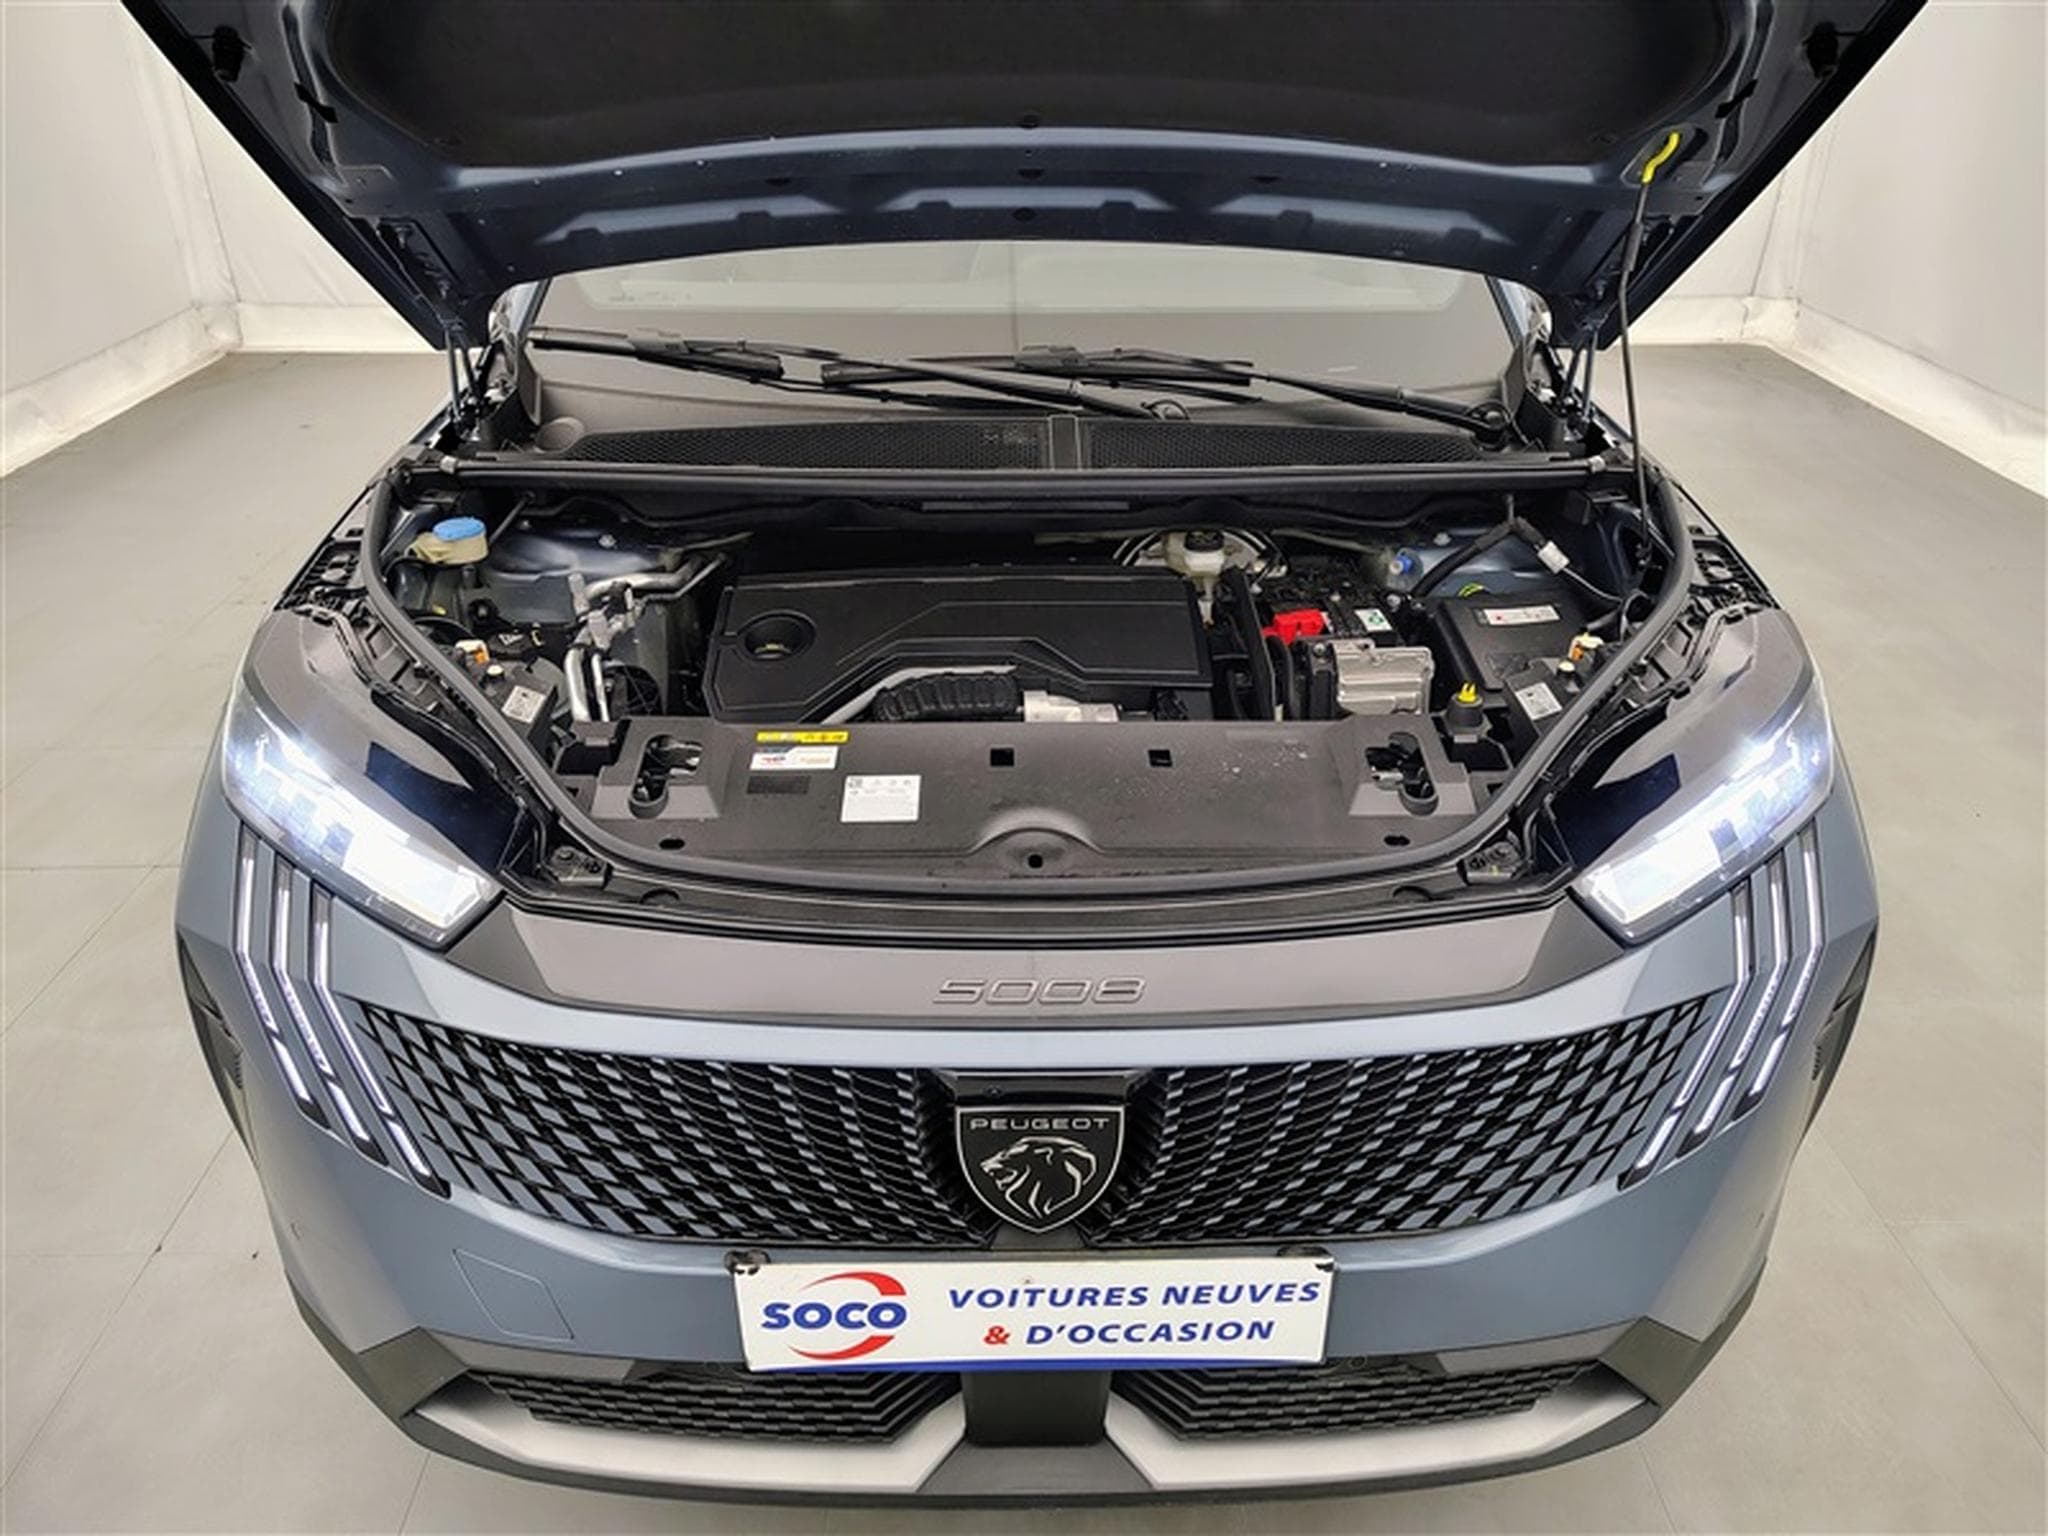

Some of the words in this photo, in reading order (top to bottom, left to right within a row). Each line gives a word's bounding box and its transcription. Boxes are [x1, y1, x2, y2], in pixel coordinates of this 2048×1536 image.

[933, 977, 1146, 1004] 5008
[970, 1118, 1110, 1130] PEUGEOT
[949, 1287, 1149, 1308] VOITURES
[1162, 1282, 1321, 1305] NEUVES
[761, 1302, 907, 1330] SOCO
[984, 1325, 1010, 1345] &
[1026, 1321, 1274, 1345] D'OCCASION
